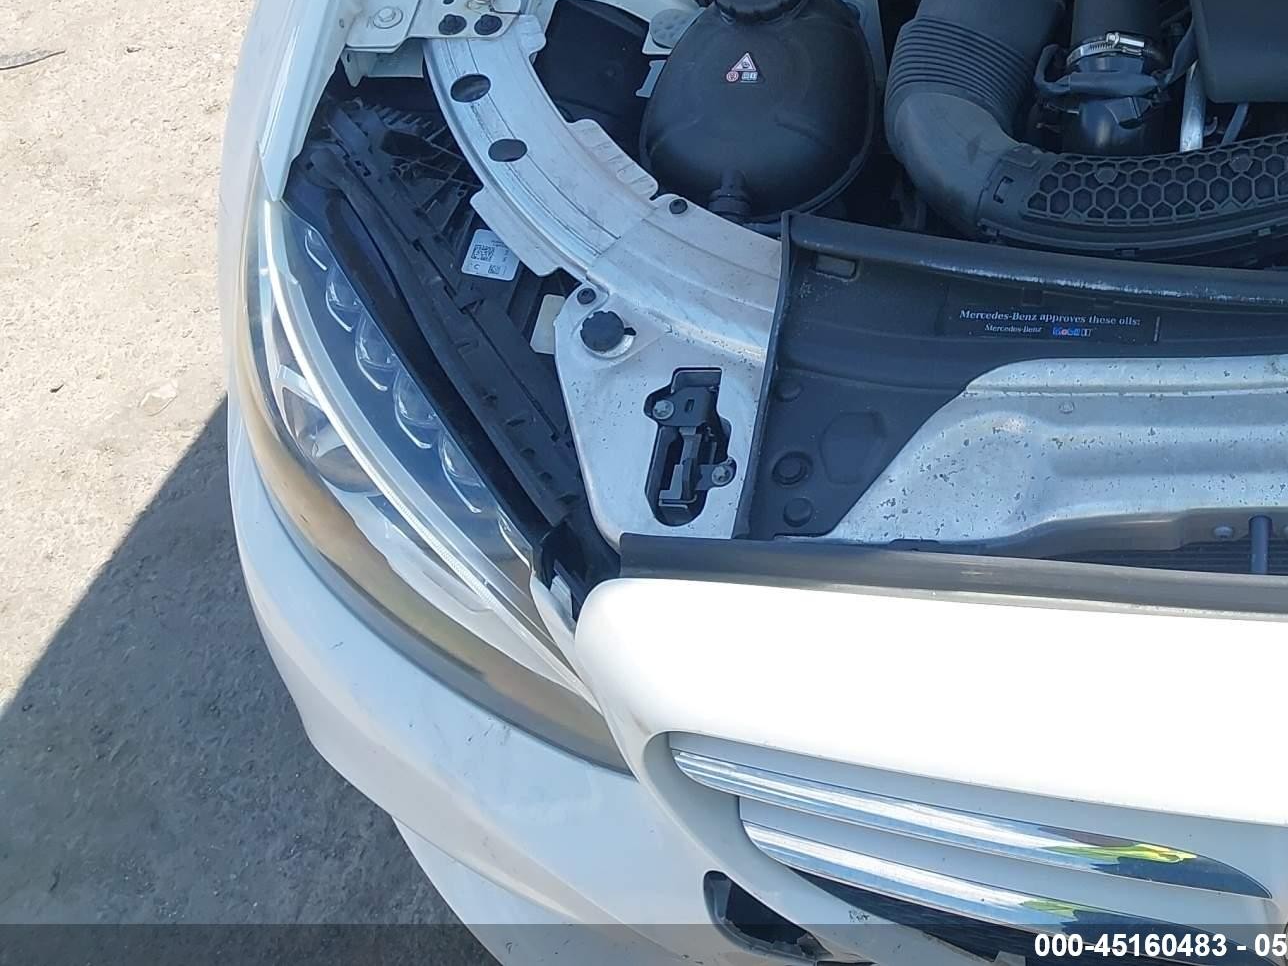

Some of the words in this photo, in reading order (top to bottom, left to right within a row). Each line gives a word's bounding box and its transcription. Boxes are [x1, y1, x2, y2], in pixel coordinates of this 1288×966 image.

[959, 310, 1038, 322] Mercedes-Benz
[1039, 313, 1086, 324] approves
[1089, 314, 1116, 325] these
[985, 323, 1042, 333] Mercedes-Benz
